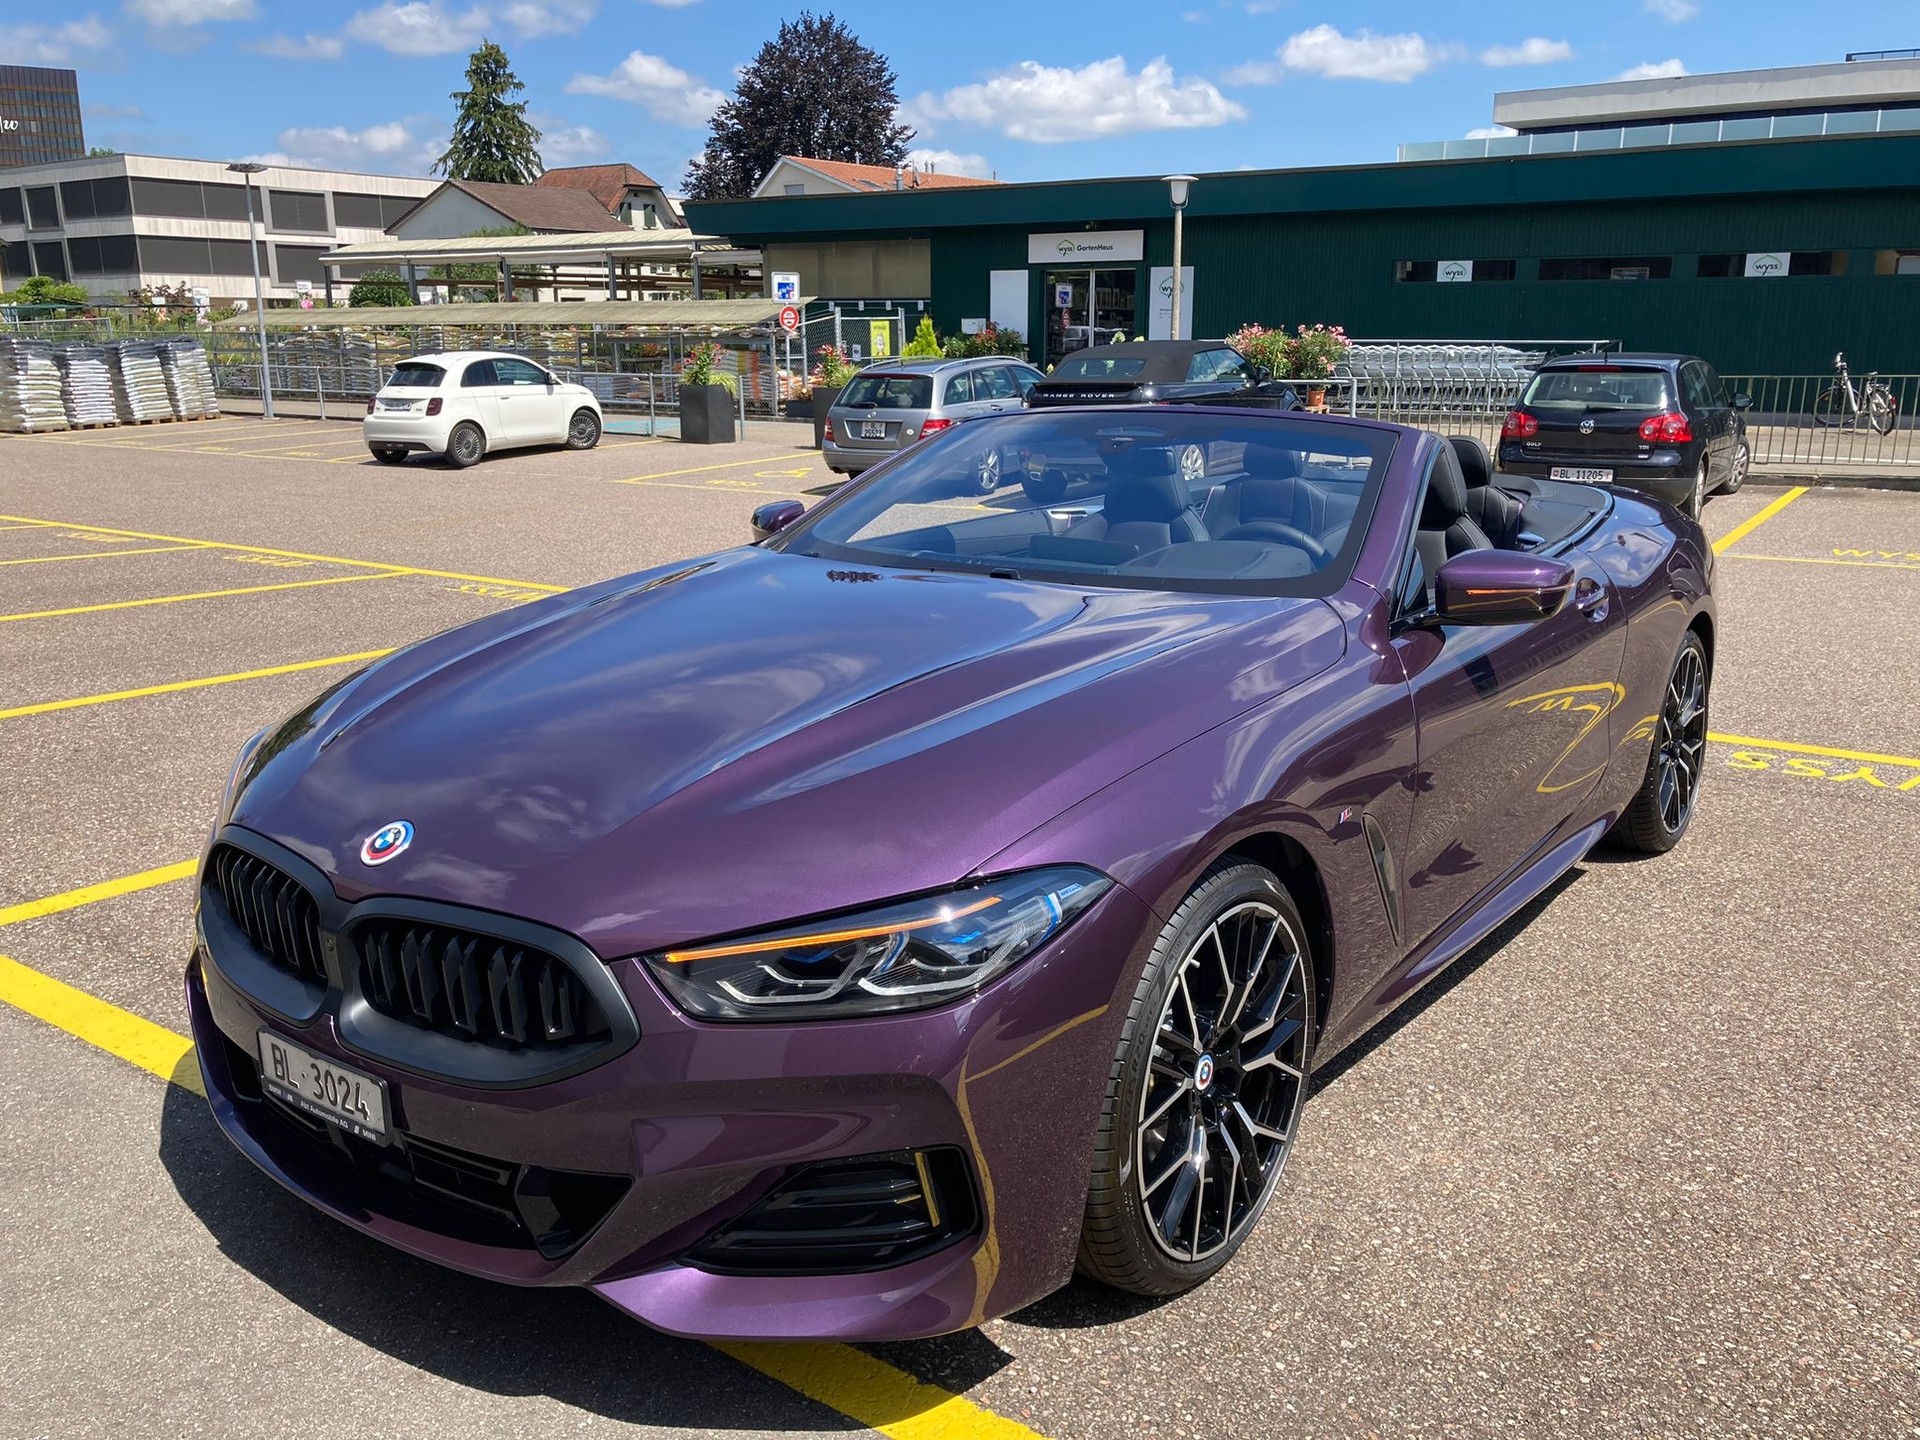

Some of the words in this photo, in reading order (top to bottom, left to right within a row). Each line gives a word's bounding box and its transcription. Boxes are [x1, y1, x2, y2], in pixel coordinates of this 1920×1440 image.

[1059, 246, 1073, 257] wyss
[1076, 244, 1114, 252] GartenHaus
[1445, 270, 1464, 281] wyss
[1755, 263, 1779, 276] wyss
[1576, 469, 1604, 481] 11205
[310, 1062, 371, 1122] 3024
